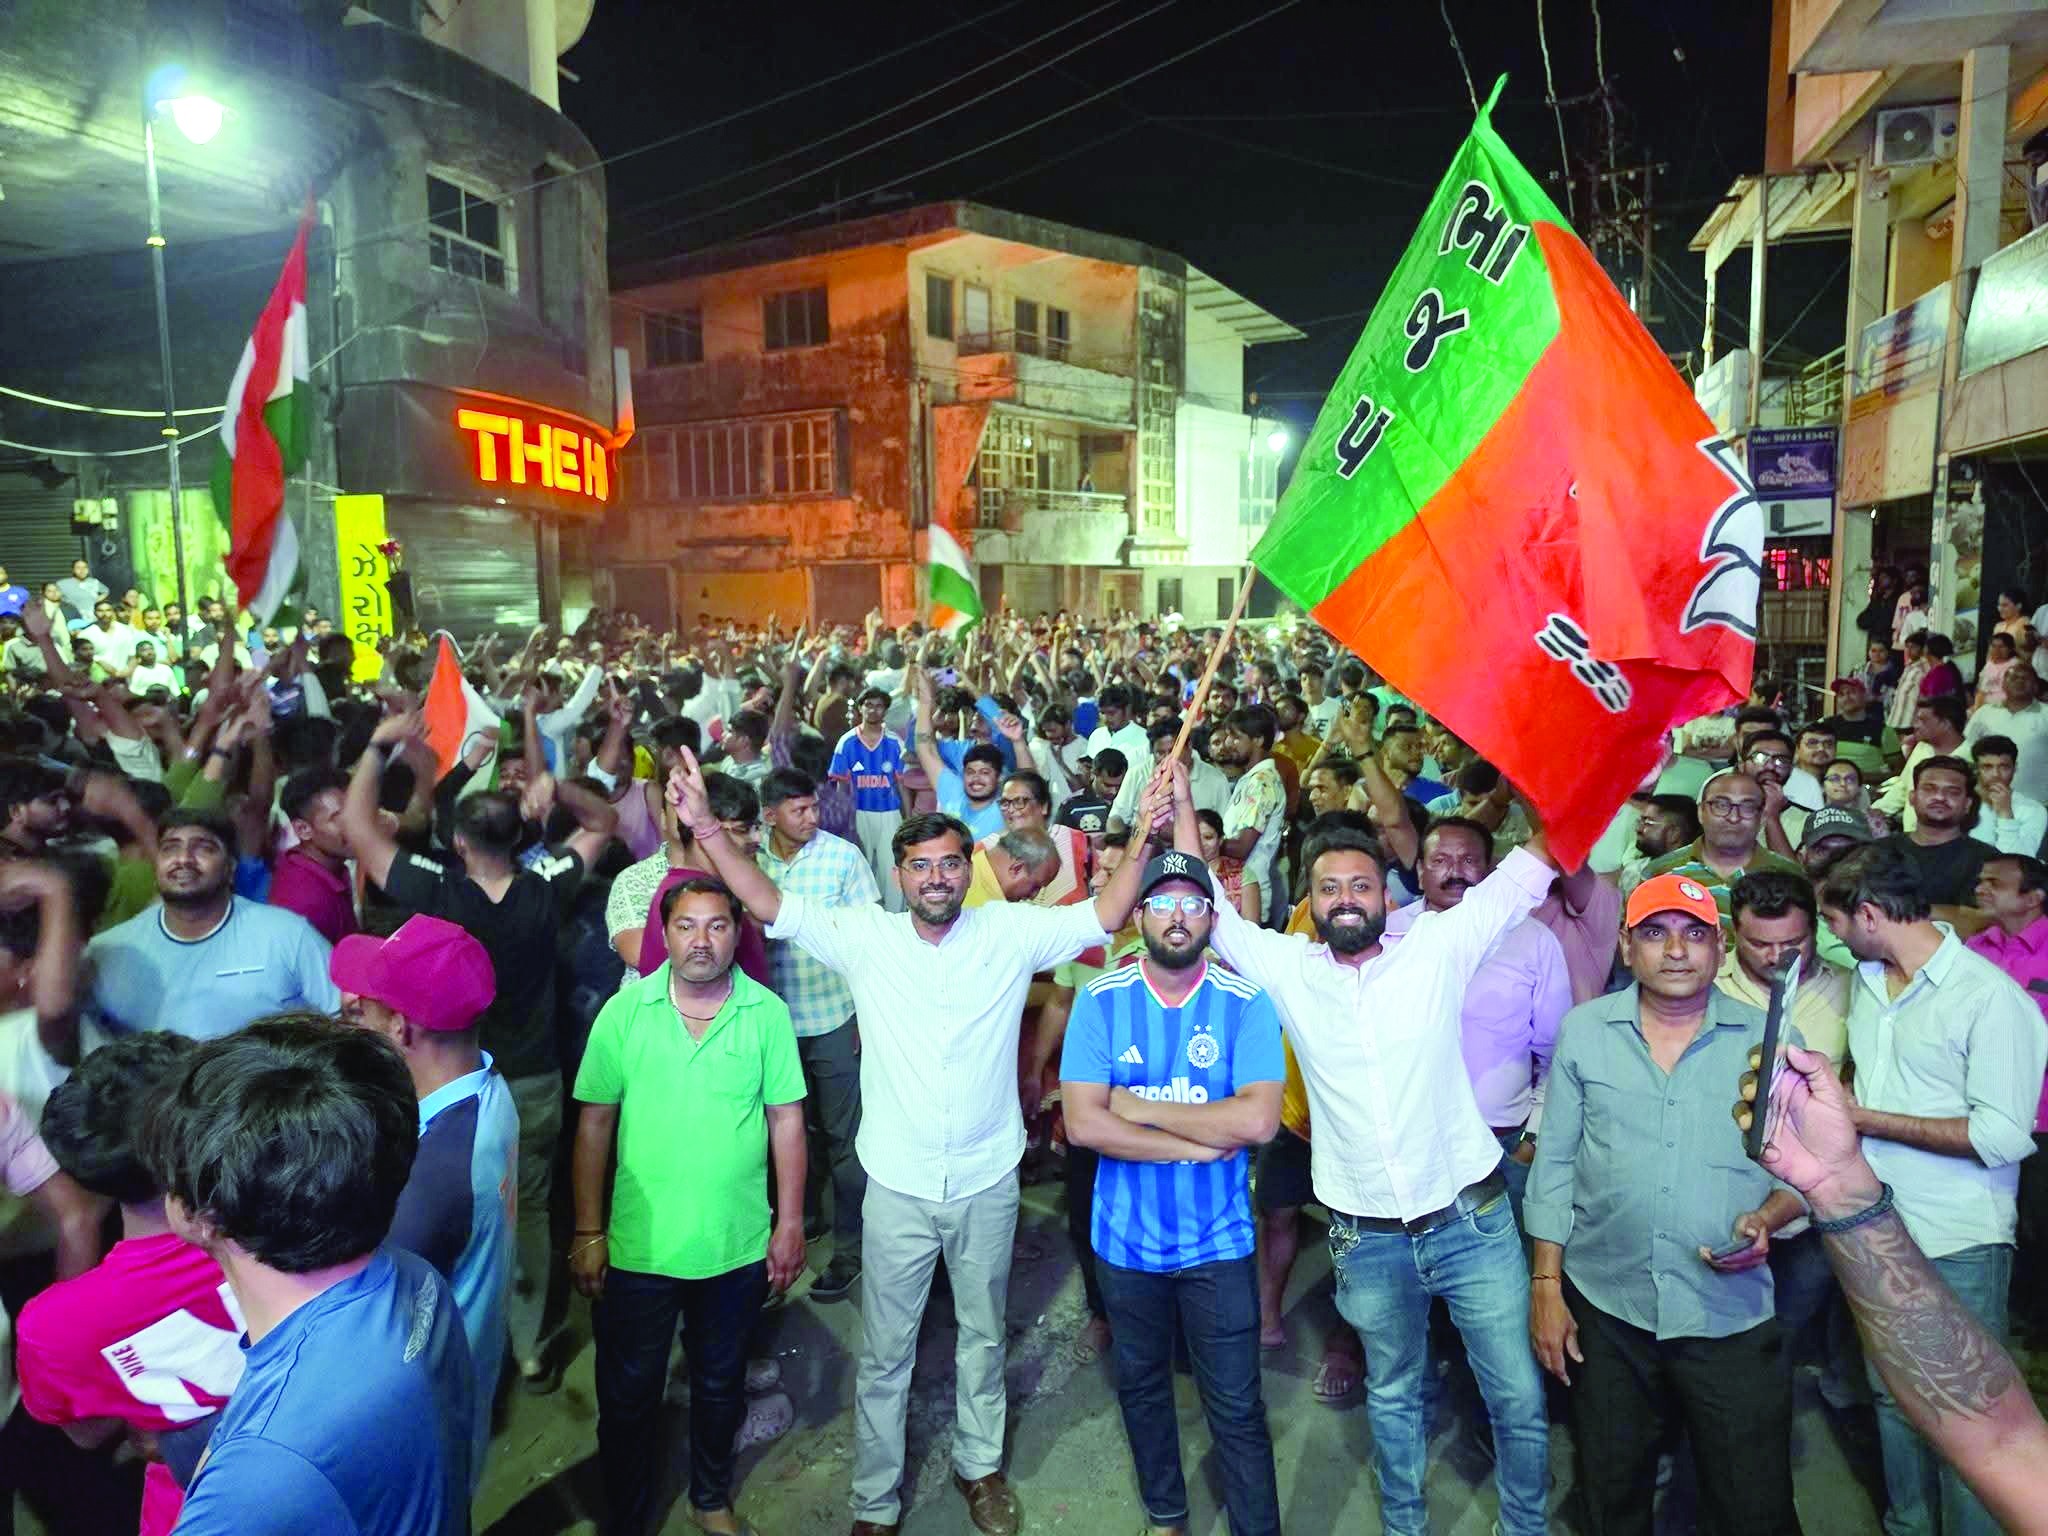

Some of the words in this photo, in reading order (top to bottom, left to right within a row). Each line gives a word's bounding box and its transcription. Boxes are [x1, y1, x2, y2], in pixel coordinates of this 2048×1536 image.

[856, 775, 891, 789] INDIA
[1816, 807, 1848, 818] ROYAL
[1813, 815, 1854, 829] ENFIELD
[112, 1344, 146, 1377] NIKE
